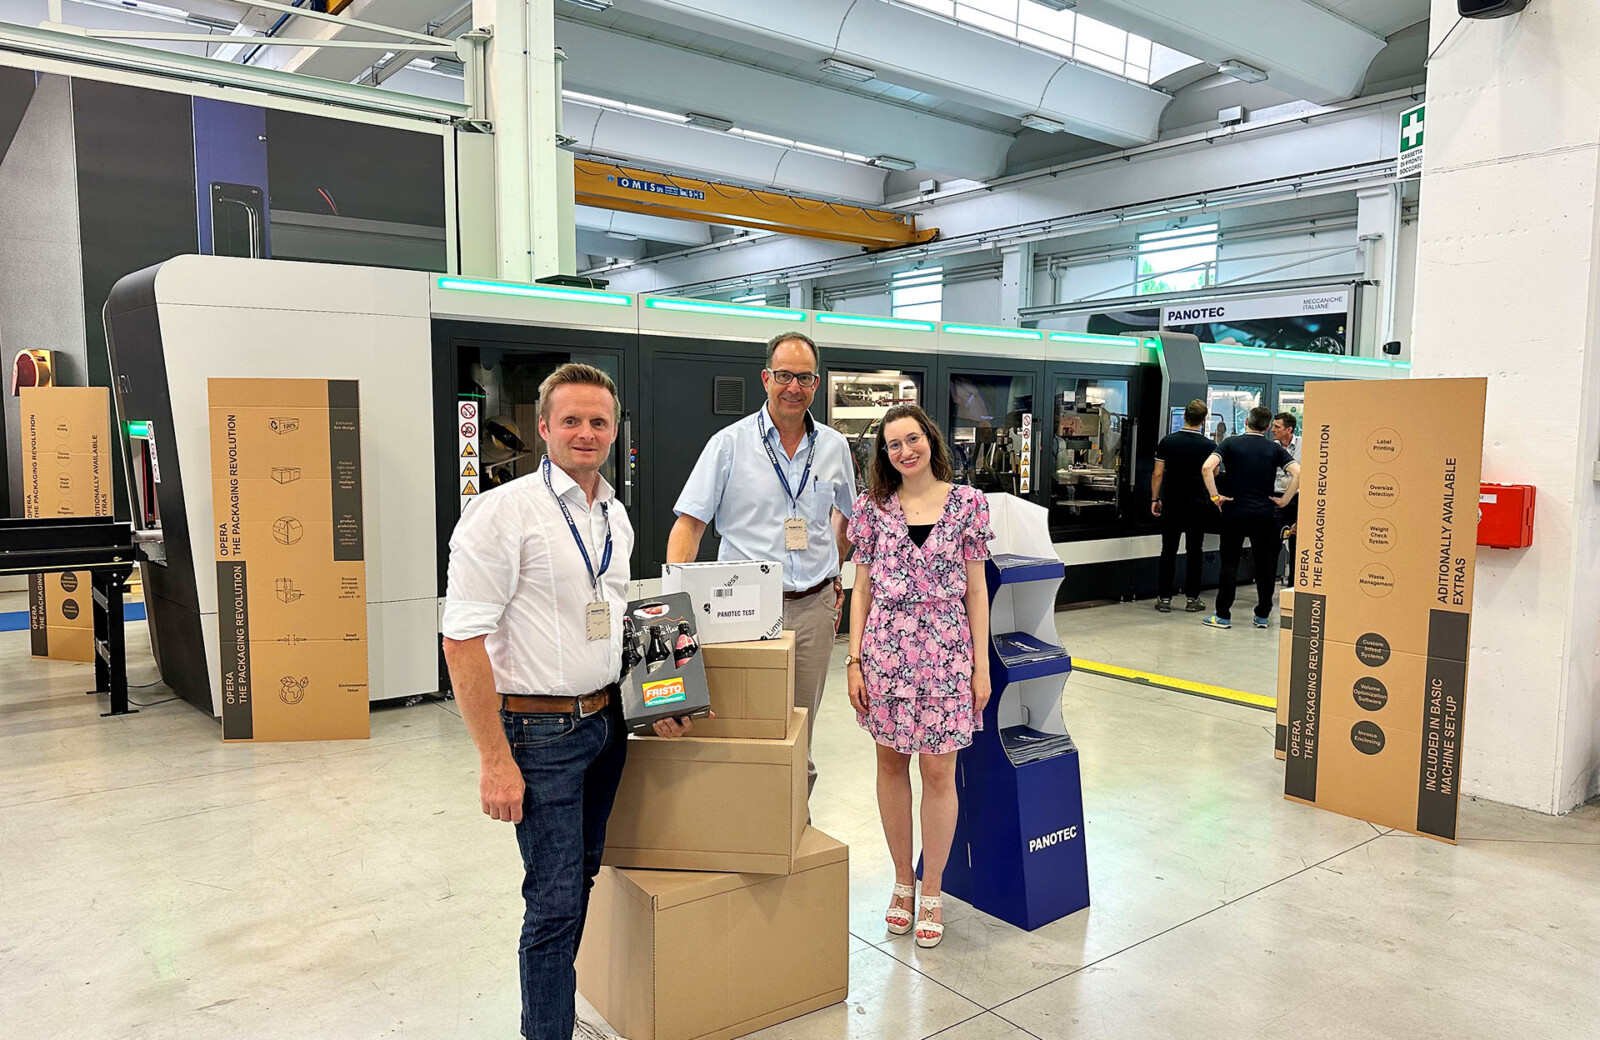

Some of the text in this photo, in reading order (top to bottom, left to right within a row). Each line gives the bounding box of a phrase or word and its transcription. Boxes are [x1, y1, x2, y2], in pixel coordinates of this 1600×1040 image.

[1401, 149, 1422, 160] CASSETTA
[621, 178, 655, 192] OMIS
[1168, 307, 1225, 321] PANOTEC
[765, 442, 777, 464] PANOTEC
[227, 414, 241, 556] THE PACKAGING REVOLUTION
[1313, 424, 1330, 588] THE PACKAGING REVOLUTION
[219, 522, 229, 556] OPERA
[1438, 458, 1456, 604] ADITIONALLY AVAILABLE
[1300, 549, 1310, 587] OPERA
[1360, 579, 1393, 587] Management
[1453, 558, 1466, 605] EXTRAS
[234, 566, 248, 704] THE PACKAGING REVOLUTION
[226, 671, 235, 704] OPERA
[647, 685, 681, 698] FRISTO
[1304, 600, 1320, 759] THE PACKAGING REVOLUTION
[1354, 689, 1387, 699] Optimization
[1358, 696, 1382, 705] Software
[1291, 720, 1301, 757] OPERA
[1355, 736, 1381, 746] Enclosing
[1358, 730, 1377, 738] Invoice
[1426, 678, 1442, 791] INCLUDED IN BASIC
[1441, 695, 1456, 794] MACHINE SET-UP
[1029, 826, 1077, 853] PANOTEC
